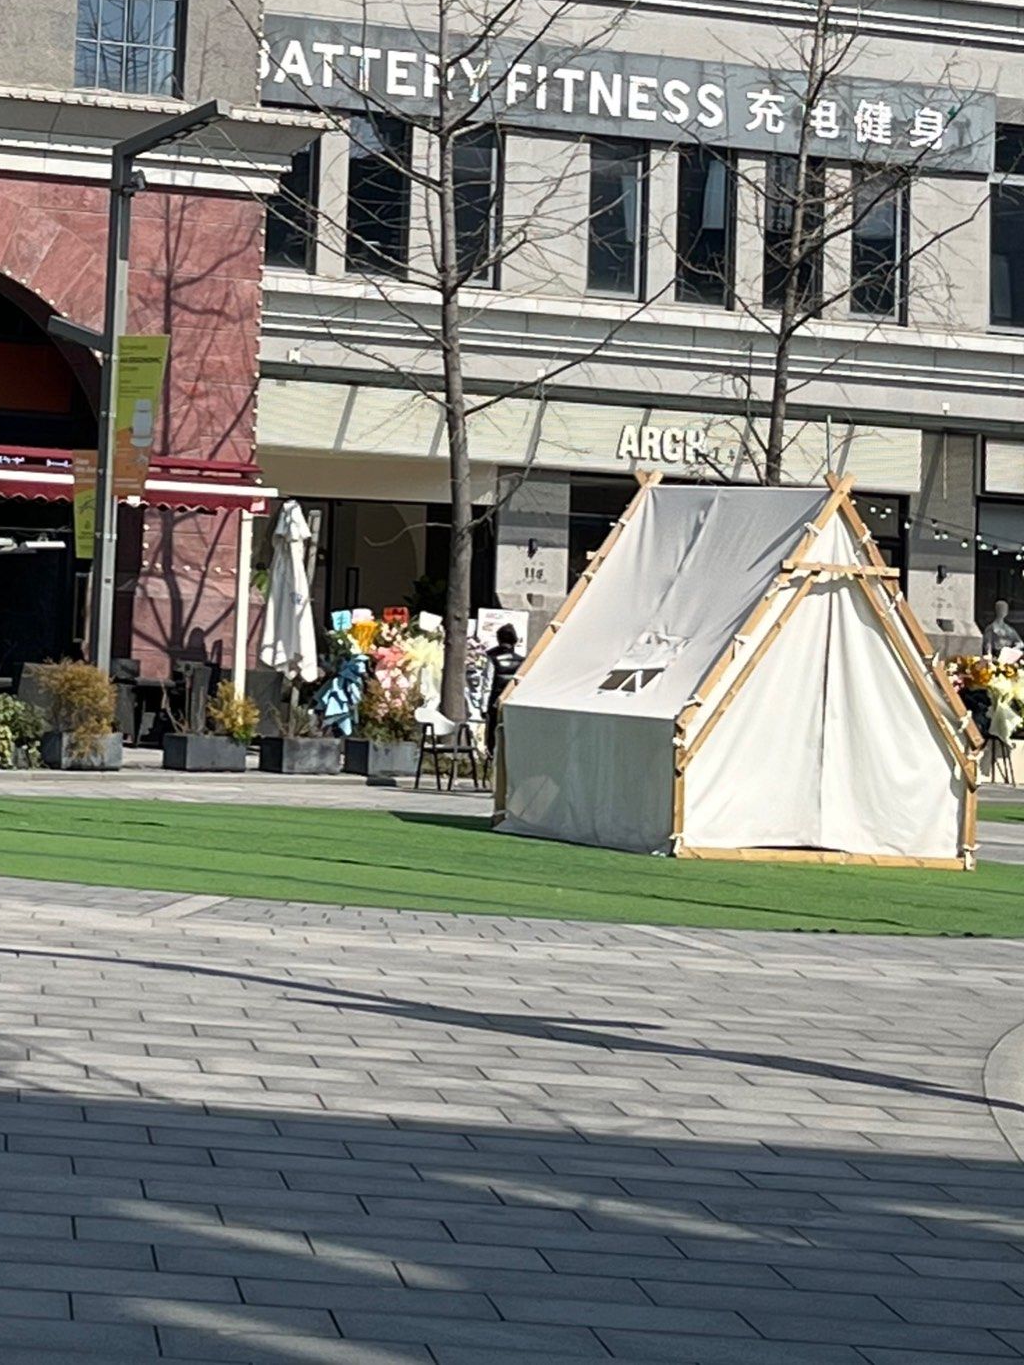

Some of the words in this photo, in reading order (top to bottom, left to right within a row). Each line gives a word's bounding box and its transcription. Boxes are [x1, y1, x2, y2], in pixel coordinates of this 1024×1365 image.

[505, 60, 725, 128] FITNESS
[745, 88, 948, 151] 充电健身
[616, 424, 707, 466] ARCH
